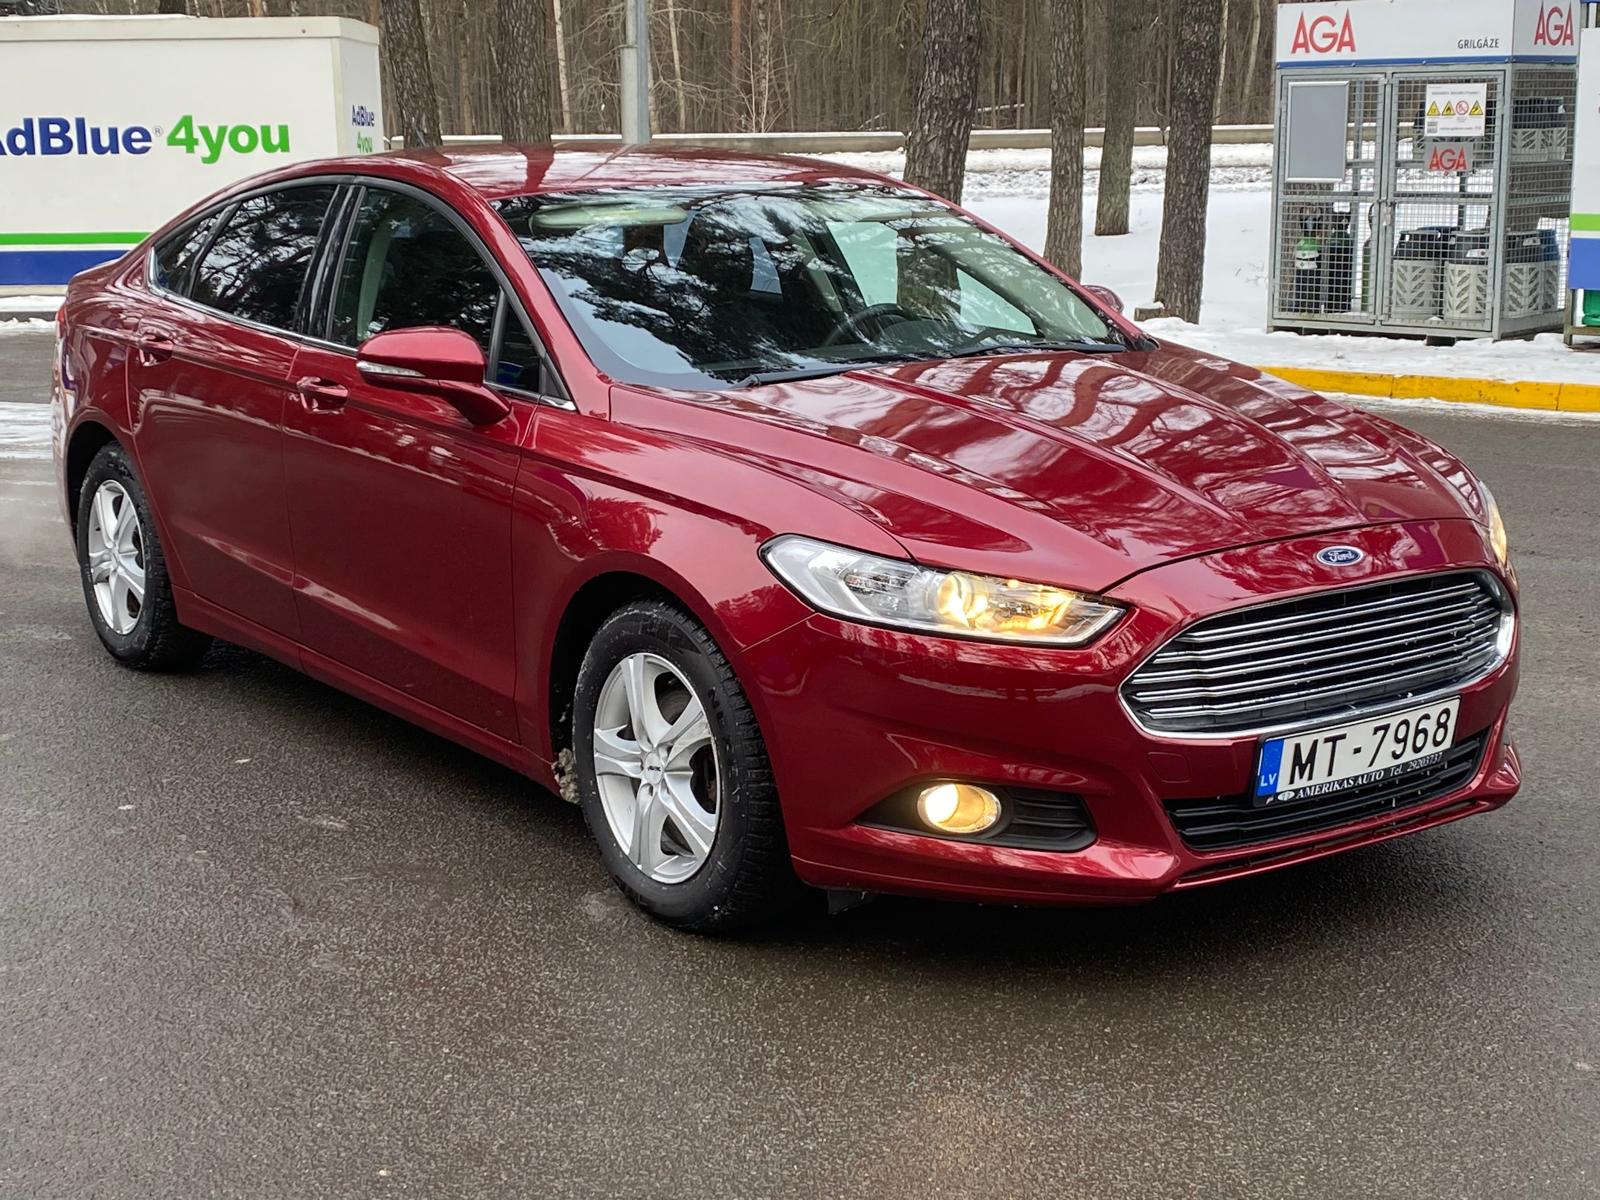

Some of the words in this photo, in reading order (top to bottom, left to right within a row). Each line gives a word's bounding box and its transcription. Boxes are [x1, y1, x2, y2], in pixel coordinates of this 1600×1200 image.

[1291, 8, 1356, 53] AGA
[1534, 1, 1574, 46] AGA
[352, 104, 375, 127] AdBlue
[167, 115, 291, 165] 4you
[1429, 145, 1467, 171] AGA
[1327, 550, 1355, 562] Ford
[1260, 772, 1277, 787] LV
[1296, 777, 1355, 800] AMERIKAS
[1355, 769, 1384, 786] AUTO
